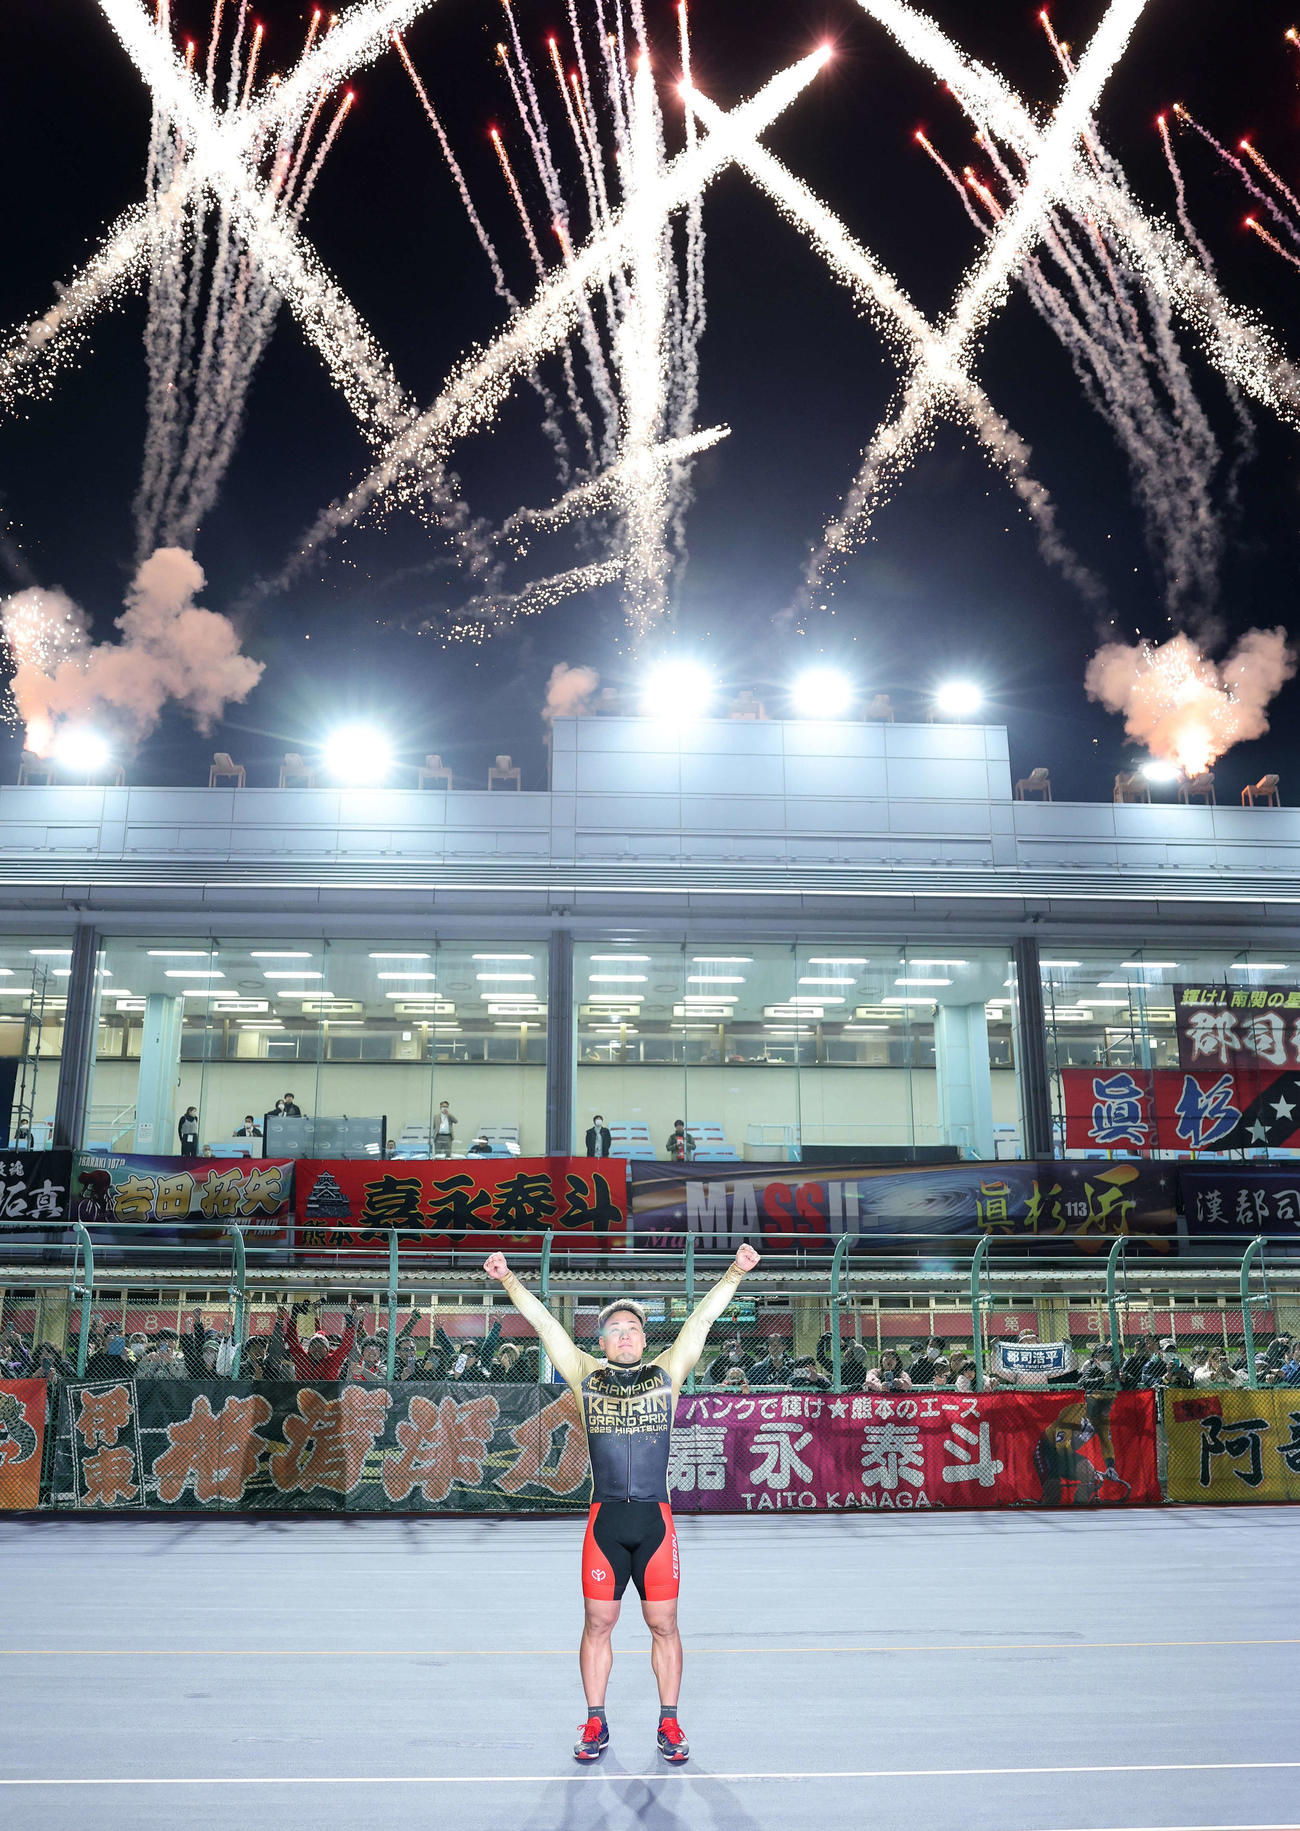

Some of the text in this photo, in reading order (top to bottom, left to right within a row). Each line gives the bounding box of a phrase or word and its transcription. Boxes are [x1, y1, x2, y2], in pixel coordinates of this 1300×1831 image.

[358, 1172, 623, 1242] 嘉永泰斗
[1065, 1201, 1088, 1217] 113
[588, 1372, 665, 1396] CHAMPION
[588, 1393, 668, 1417] KEIRIN
[588, 1412, 668, 1426] GRAND PRIX
[589, 1424, 668, 1435] 2025 HIRATSUKA
[668, 1421, 1004, 1492] 嘉永泰斗
[741, 1490, 932, 1510] TAITO KANAGA
[671, 1533, 679, 1580] KEIRIN
